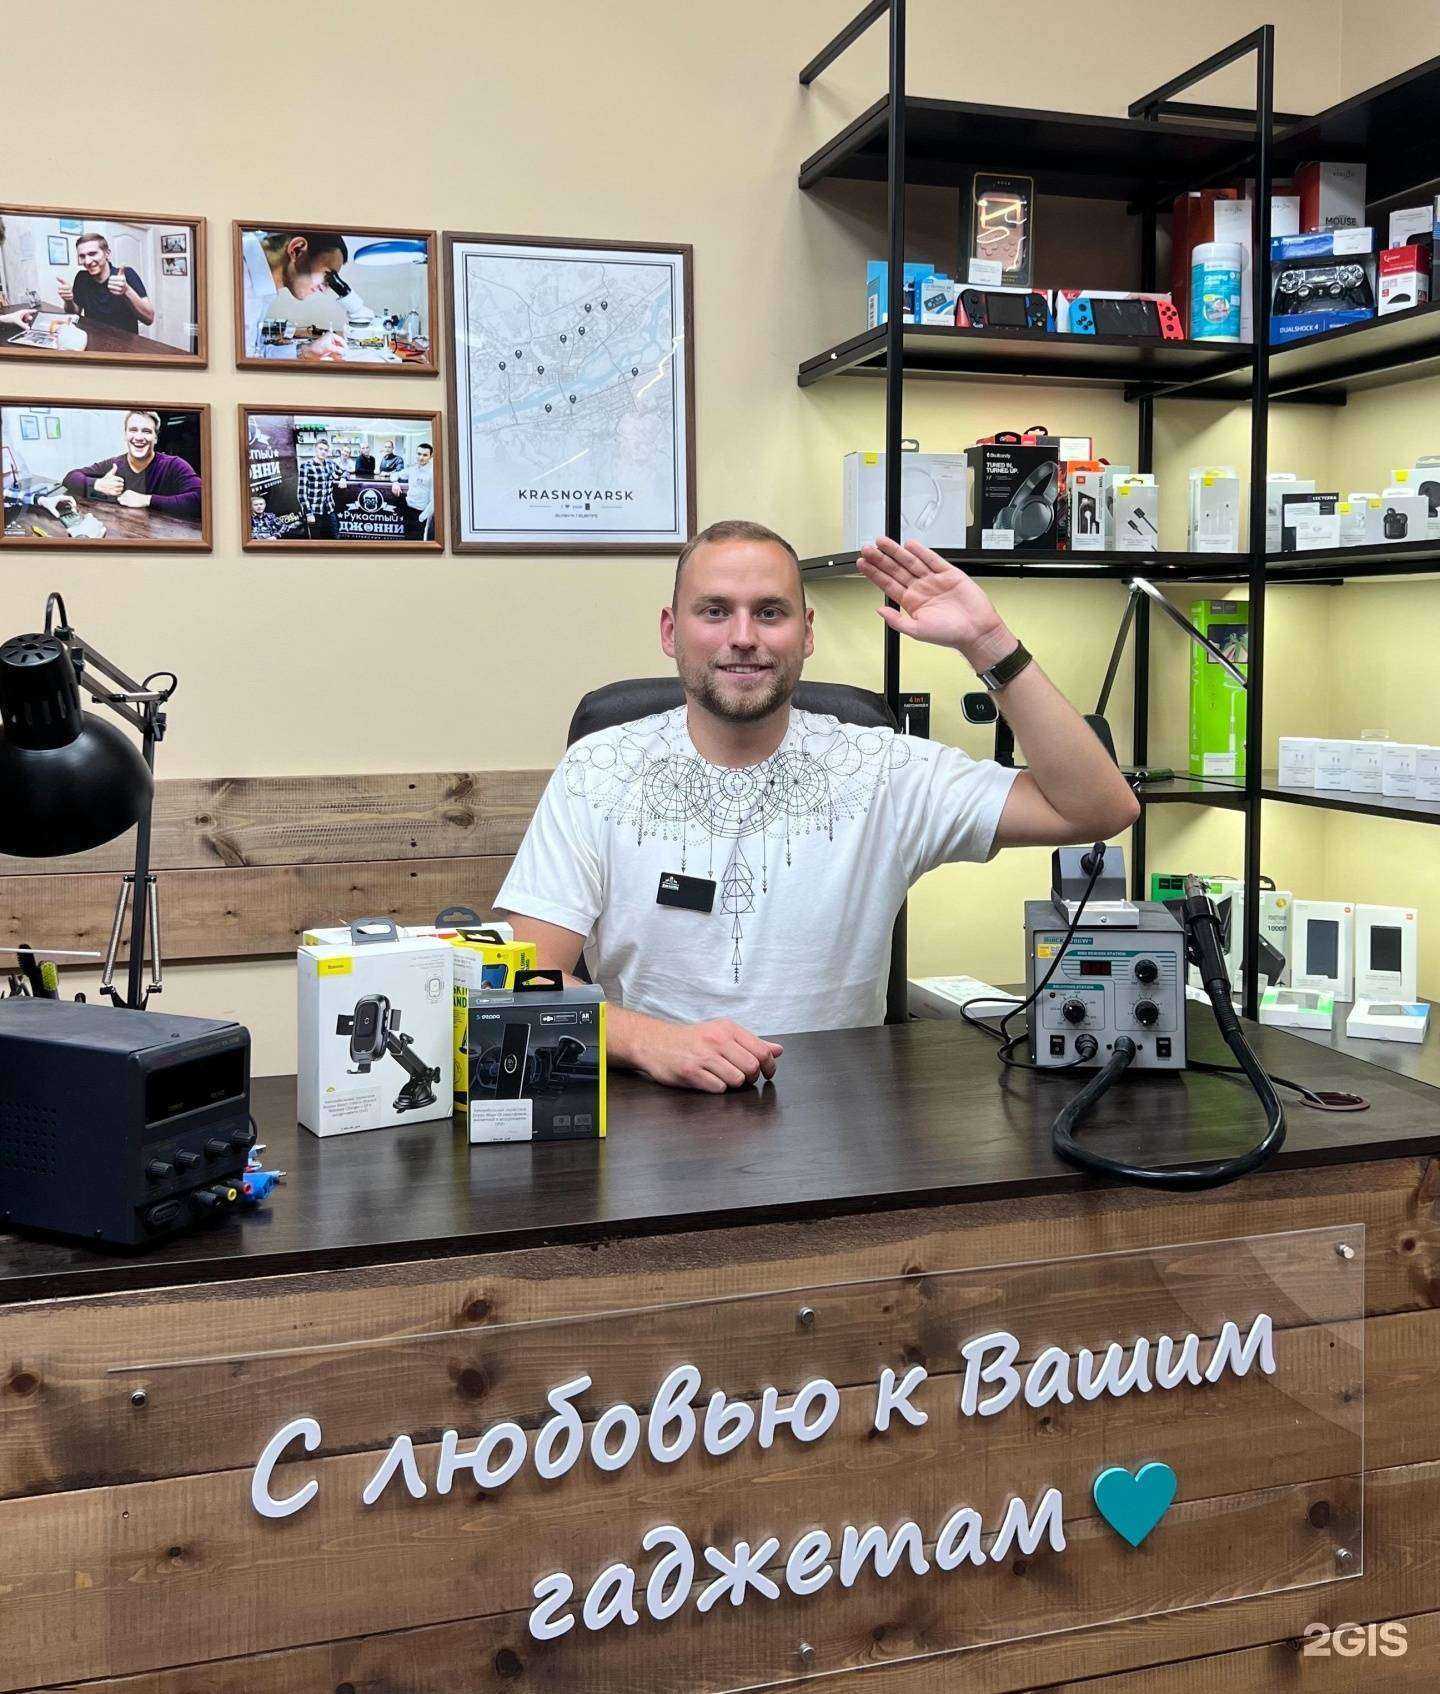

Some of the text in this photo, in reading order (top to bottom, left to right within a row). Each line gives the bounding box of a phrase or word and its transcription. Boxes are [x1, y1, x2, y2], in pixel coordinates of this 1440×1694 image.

[1325, 216, 1356, 226] MOUSE
[1279, 324, 1313, 333] DUALSHOCK
[518, 489, 634, 501] KRASNOYARSK
[344, 510, 399, 522] Рукастый
[339, 520, 405, 534] ДЖОННИ
[251, 1313, 1277, 1519] С любовью к Вашим
[528, 1488, 1067, 1641] гаджетам
